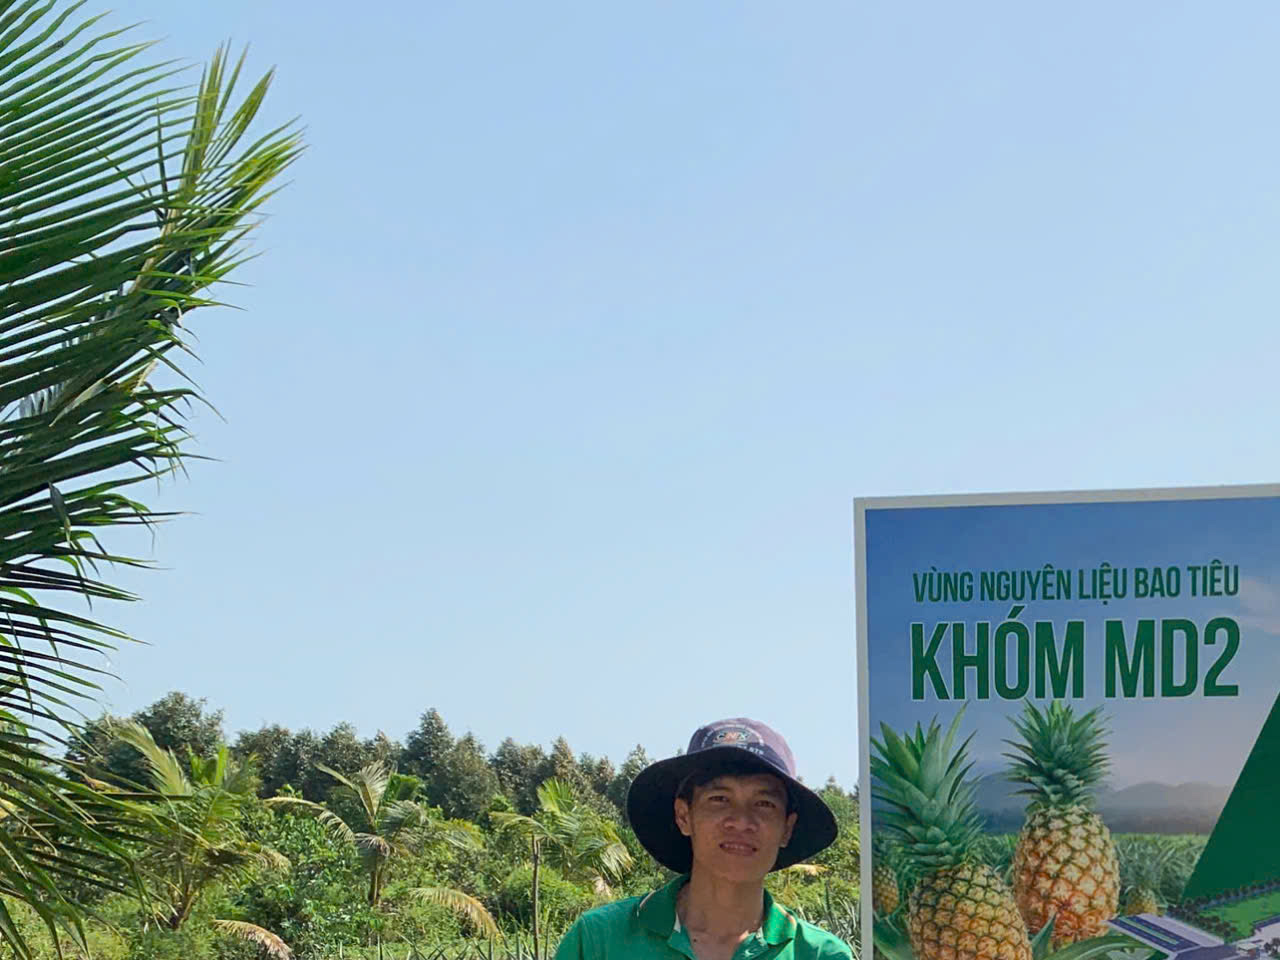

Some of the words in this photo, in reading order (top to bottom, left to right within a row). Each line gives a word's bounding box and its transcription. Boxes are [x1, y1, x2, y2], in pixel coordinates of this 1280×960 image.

[912, 566, 974, 602] VÙNG
[980, 563, 1072, 601] NGUYÊN
[1078, 562, 1127, 606] LIỆU
[1134, 566, 1181, 599] BAO
[1187, 559, 1239, 597] TIÊU
[910, 605, 1086, 700] KHÓM
[1104, 616, 1241, 698] MD2
